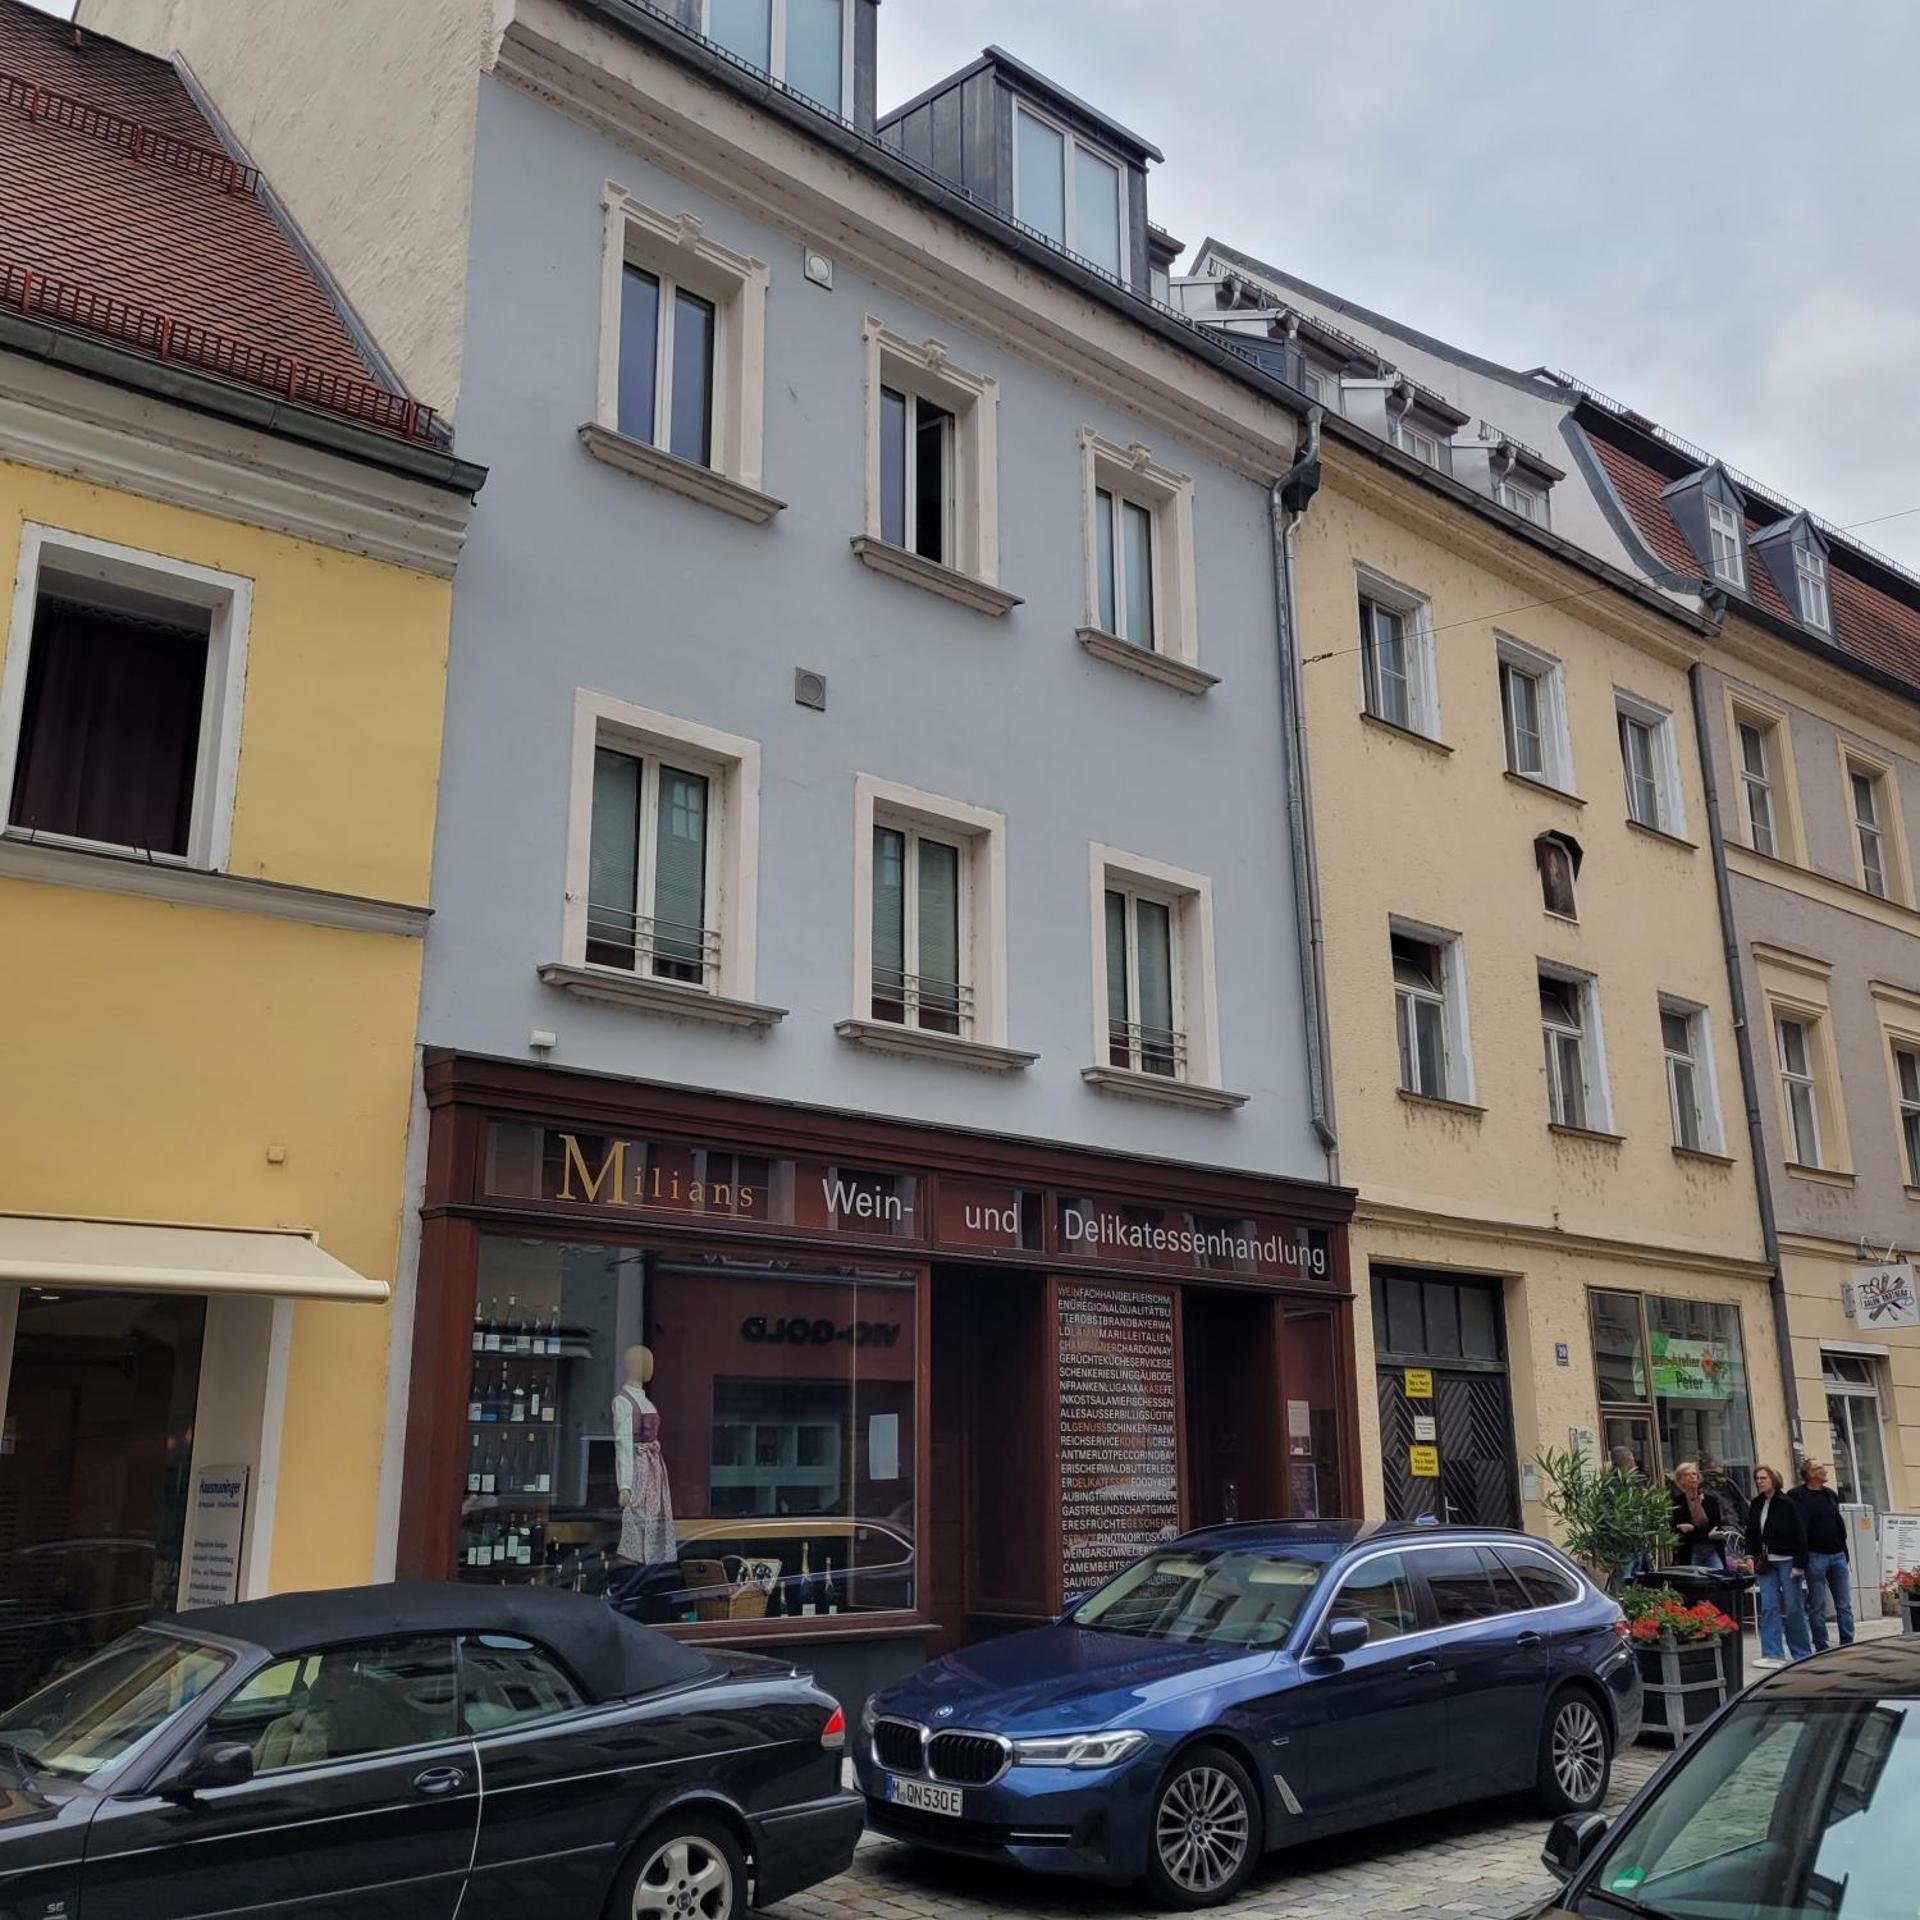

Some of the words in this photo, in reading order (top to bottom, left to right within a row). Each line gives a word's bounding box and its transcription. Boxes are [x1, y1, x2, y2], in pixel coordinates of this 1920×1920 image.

[556, 1133, 753, 1207] Milians
[822, 1178, 913, 1220] Wein-
[965, 1203, 1018, 1233] und
[1065, 1209, 1325, 1274] Delikatessenhandlung
[1675, 1371, 1704, 1390] Peter
